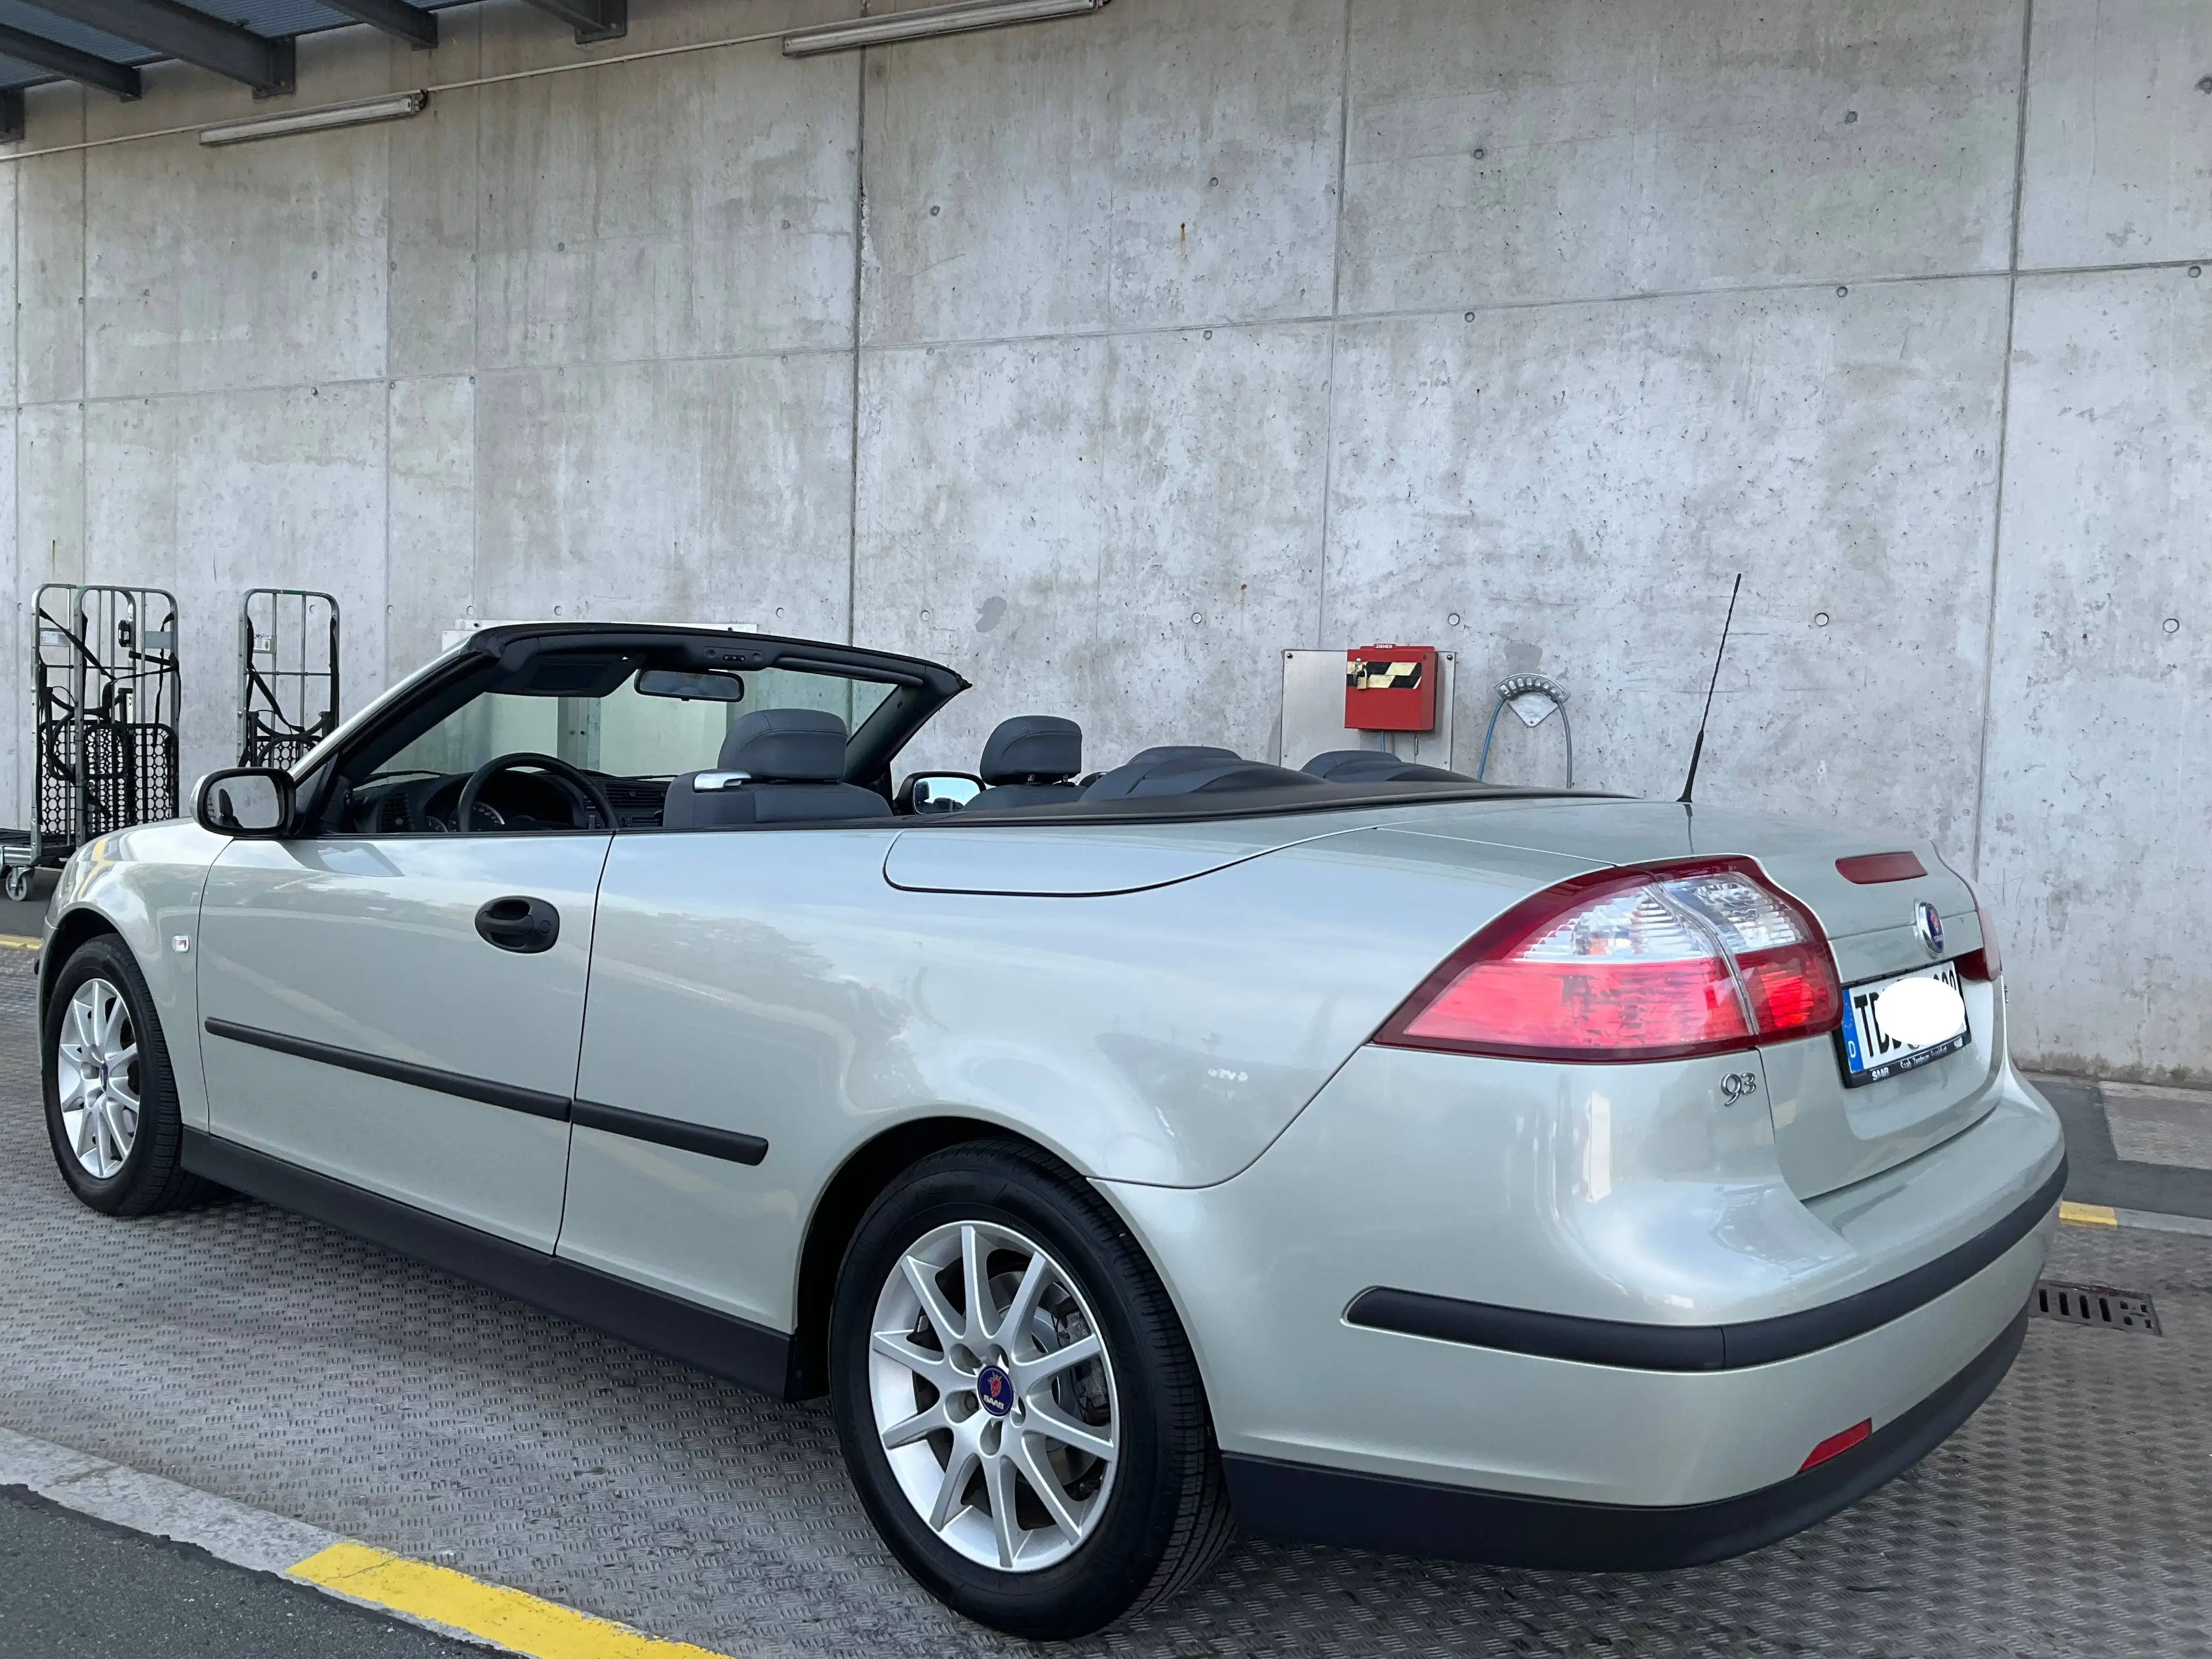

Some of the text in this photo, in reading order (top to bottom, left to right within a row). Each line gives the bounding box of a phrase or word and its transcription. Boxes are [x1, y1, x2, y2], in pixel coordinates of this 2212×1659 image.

[1848, 1040, 1856, 1058] D
[1872, 1067, 1889, 1081] SAAB
[983, 1394, 1004, 1410] SAAB
